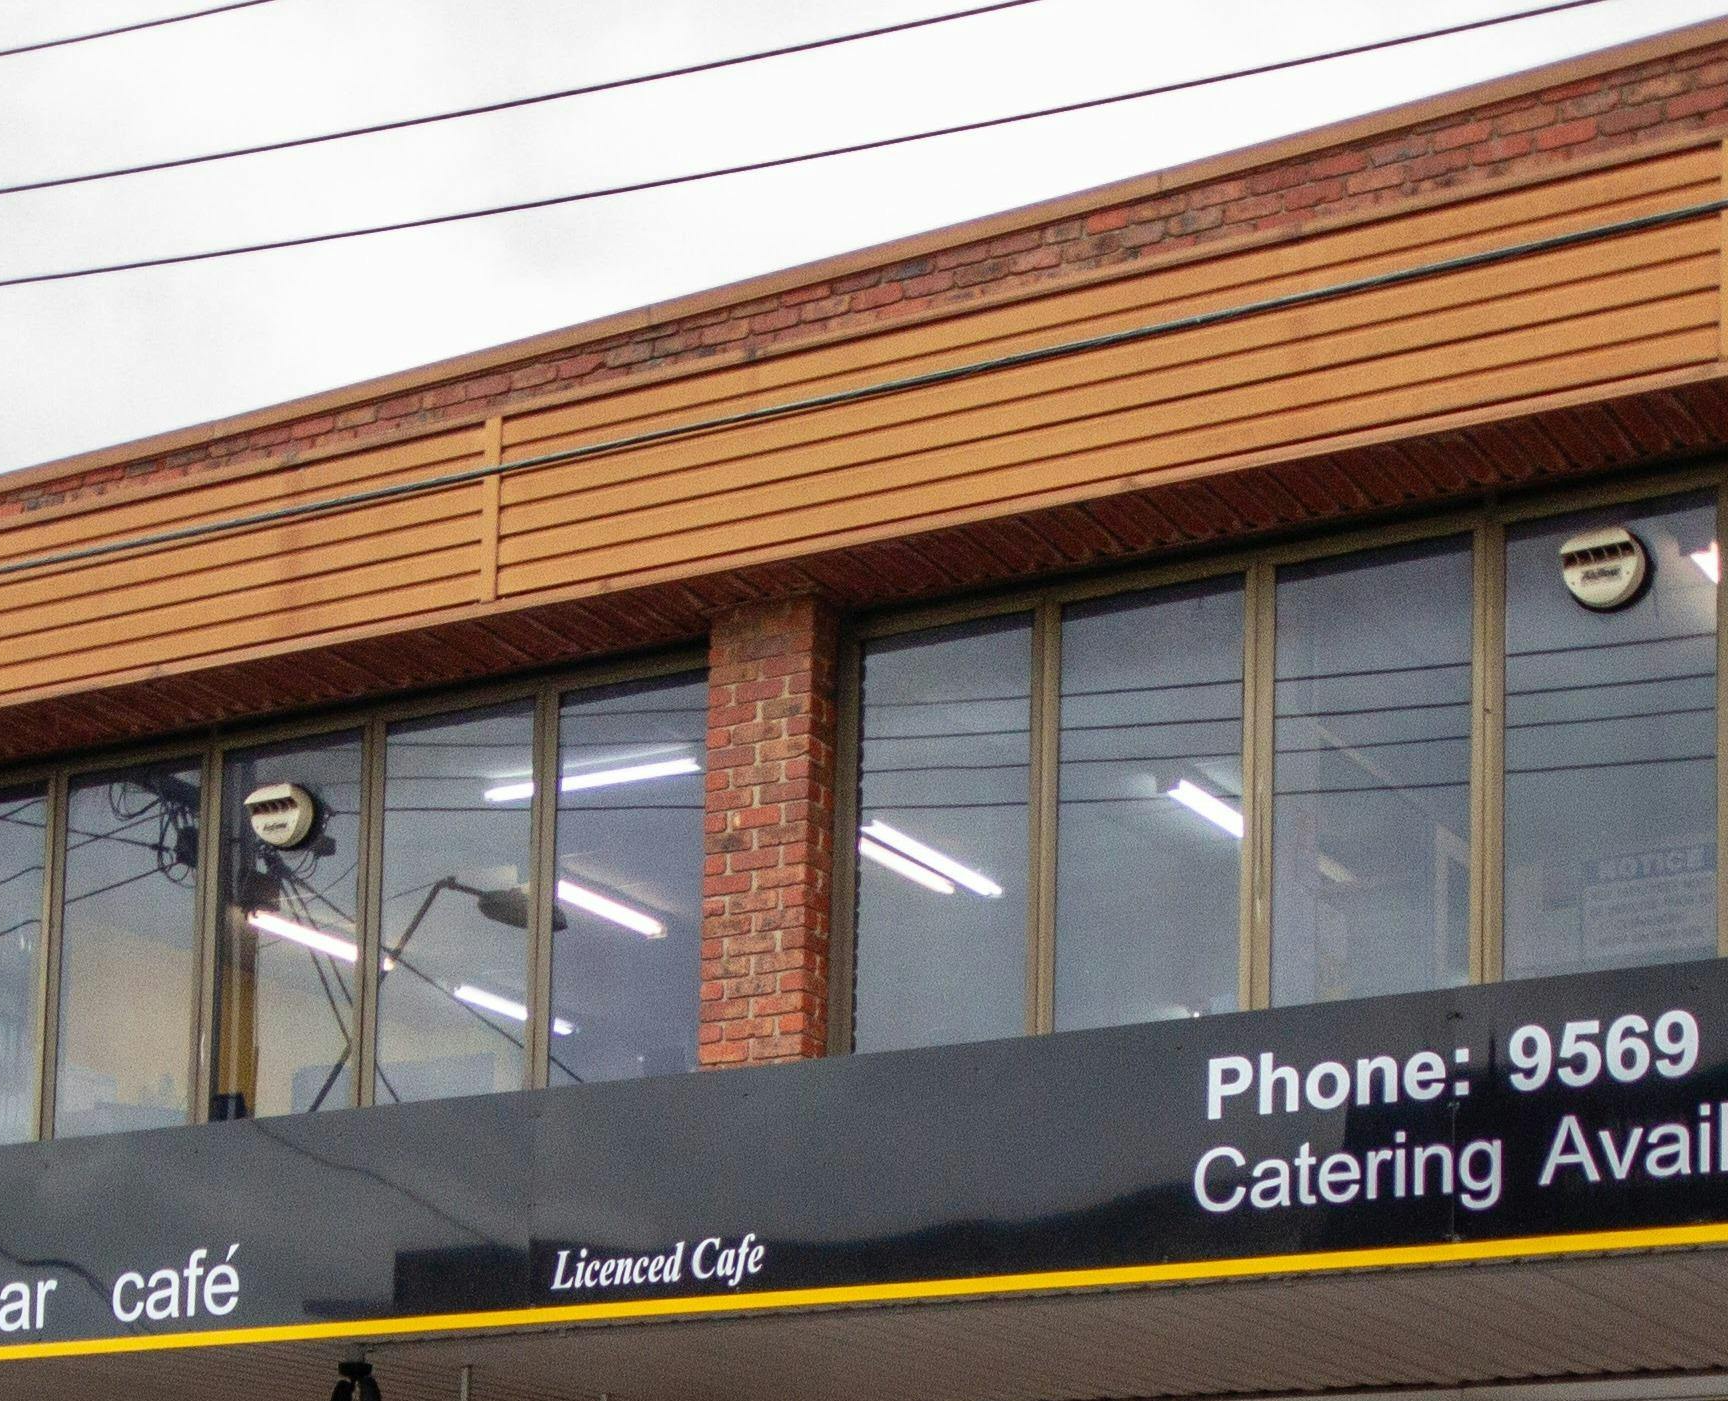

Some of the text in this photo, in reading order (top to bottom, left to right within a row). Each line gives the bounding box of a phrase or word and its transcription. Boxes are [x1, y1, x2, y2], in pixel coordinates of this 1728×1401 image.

[1206, 1046, 1472, 1120] Phone:
[1508, 1010, 1700, 1093] 9569
[1194, 1130, 1503, 1213] Catering
[112, 1243, 241, 1323] café
[549, 1232, 766, 1291] Licenced Cafe
